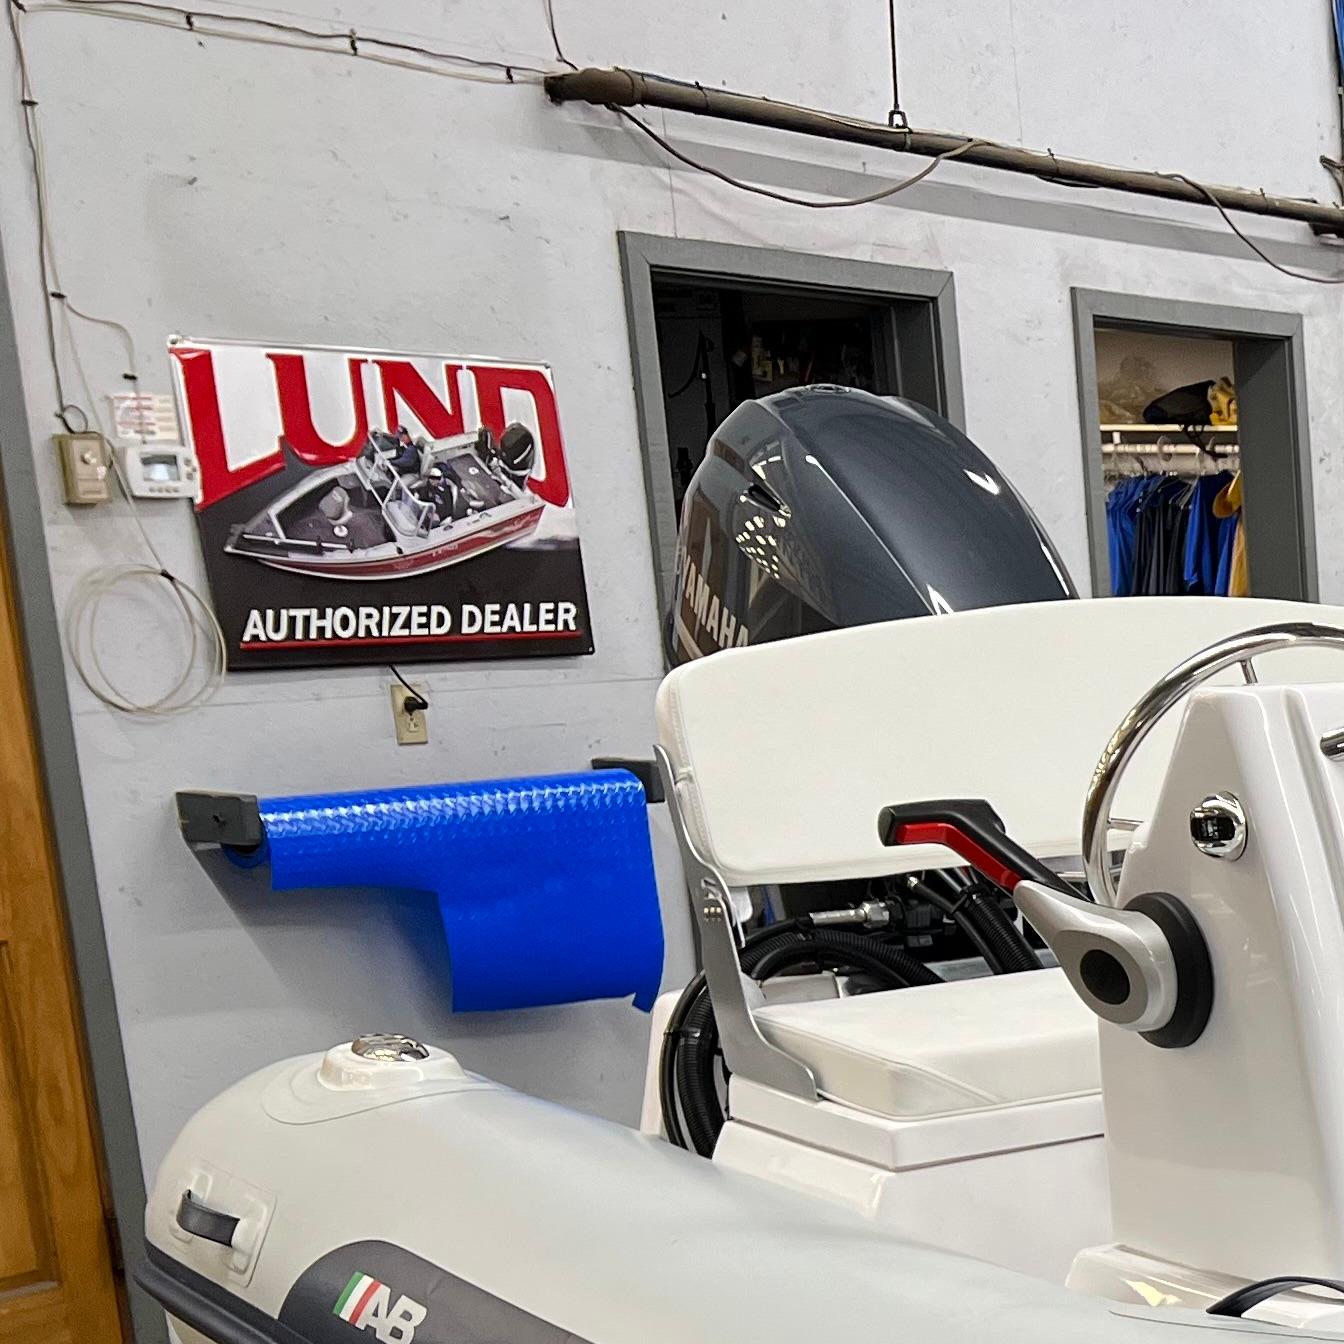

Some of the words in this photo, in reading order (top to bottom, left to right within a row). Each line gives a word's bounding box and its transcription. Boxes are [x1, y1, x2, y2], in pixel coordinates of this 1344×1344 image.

[169, 346, 571, 511] LUND
[242, 605, 453, 643] AUTHORIZED
[460, 600, 578, 635] DEALER
[681, 554, 749, 648] YAMAHA
